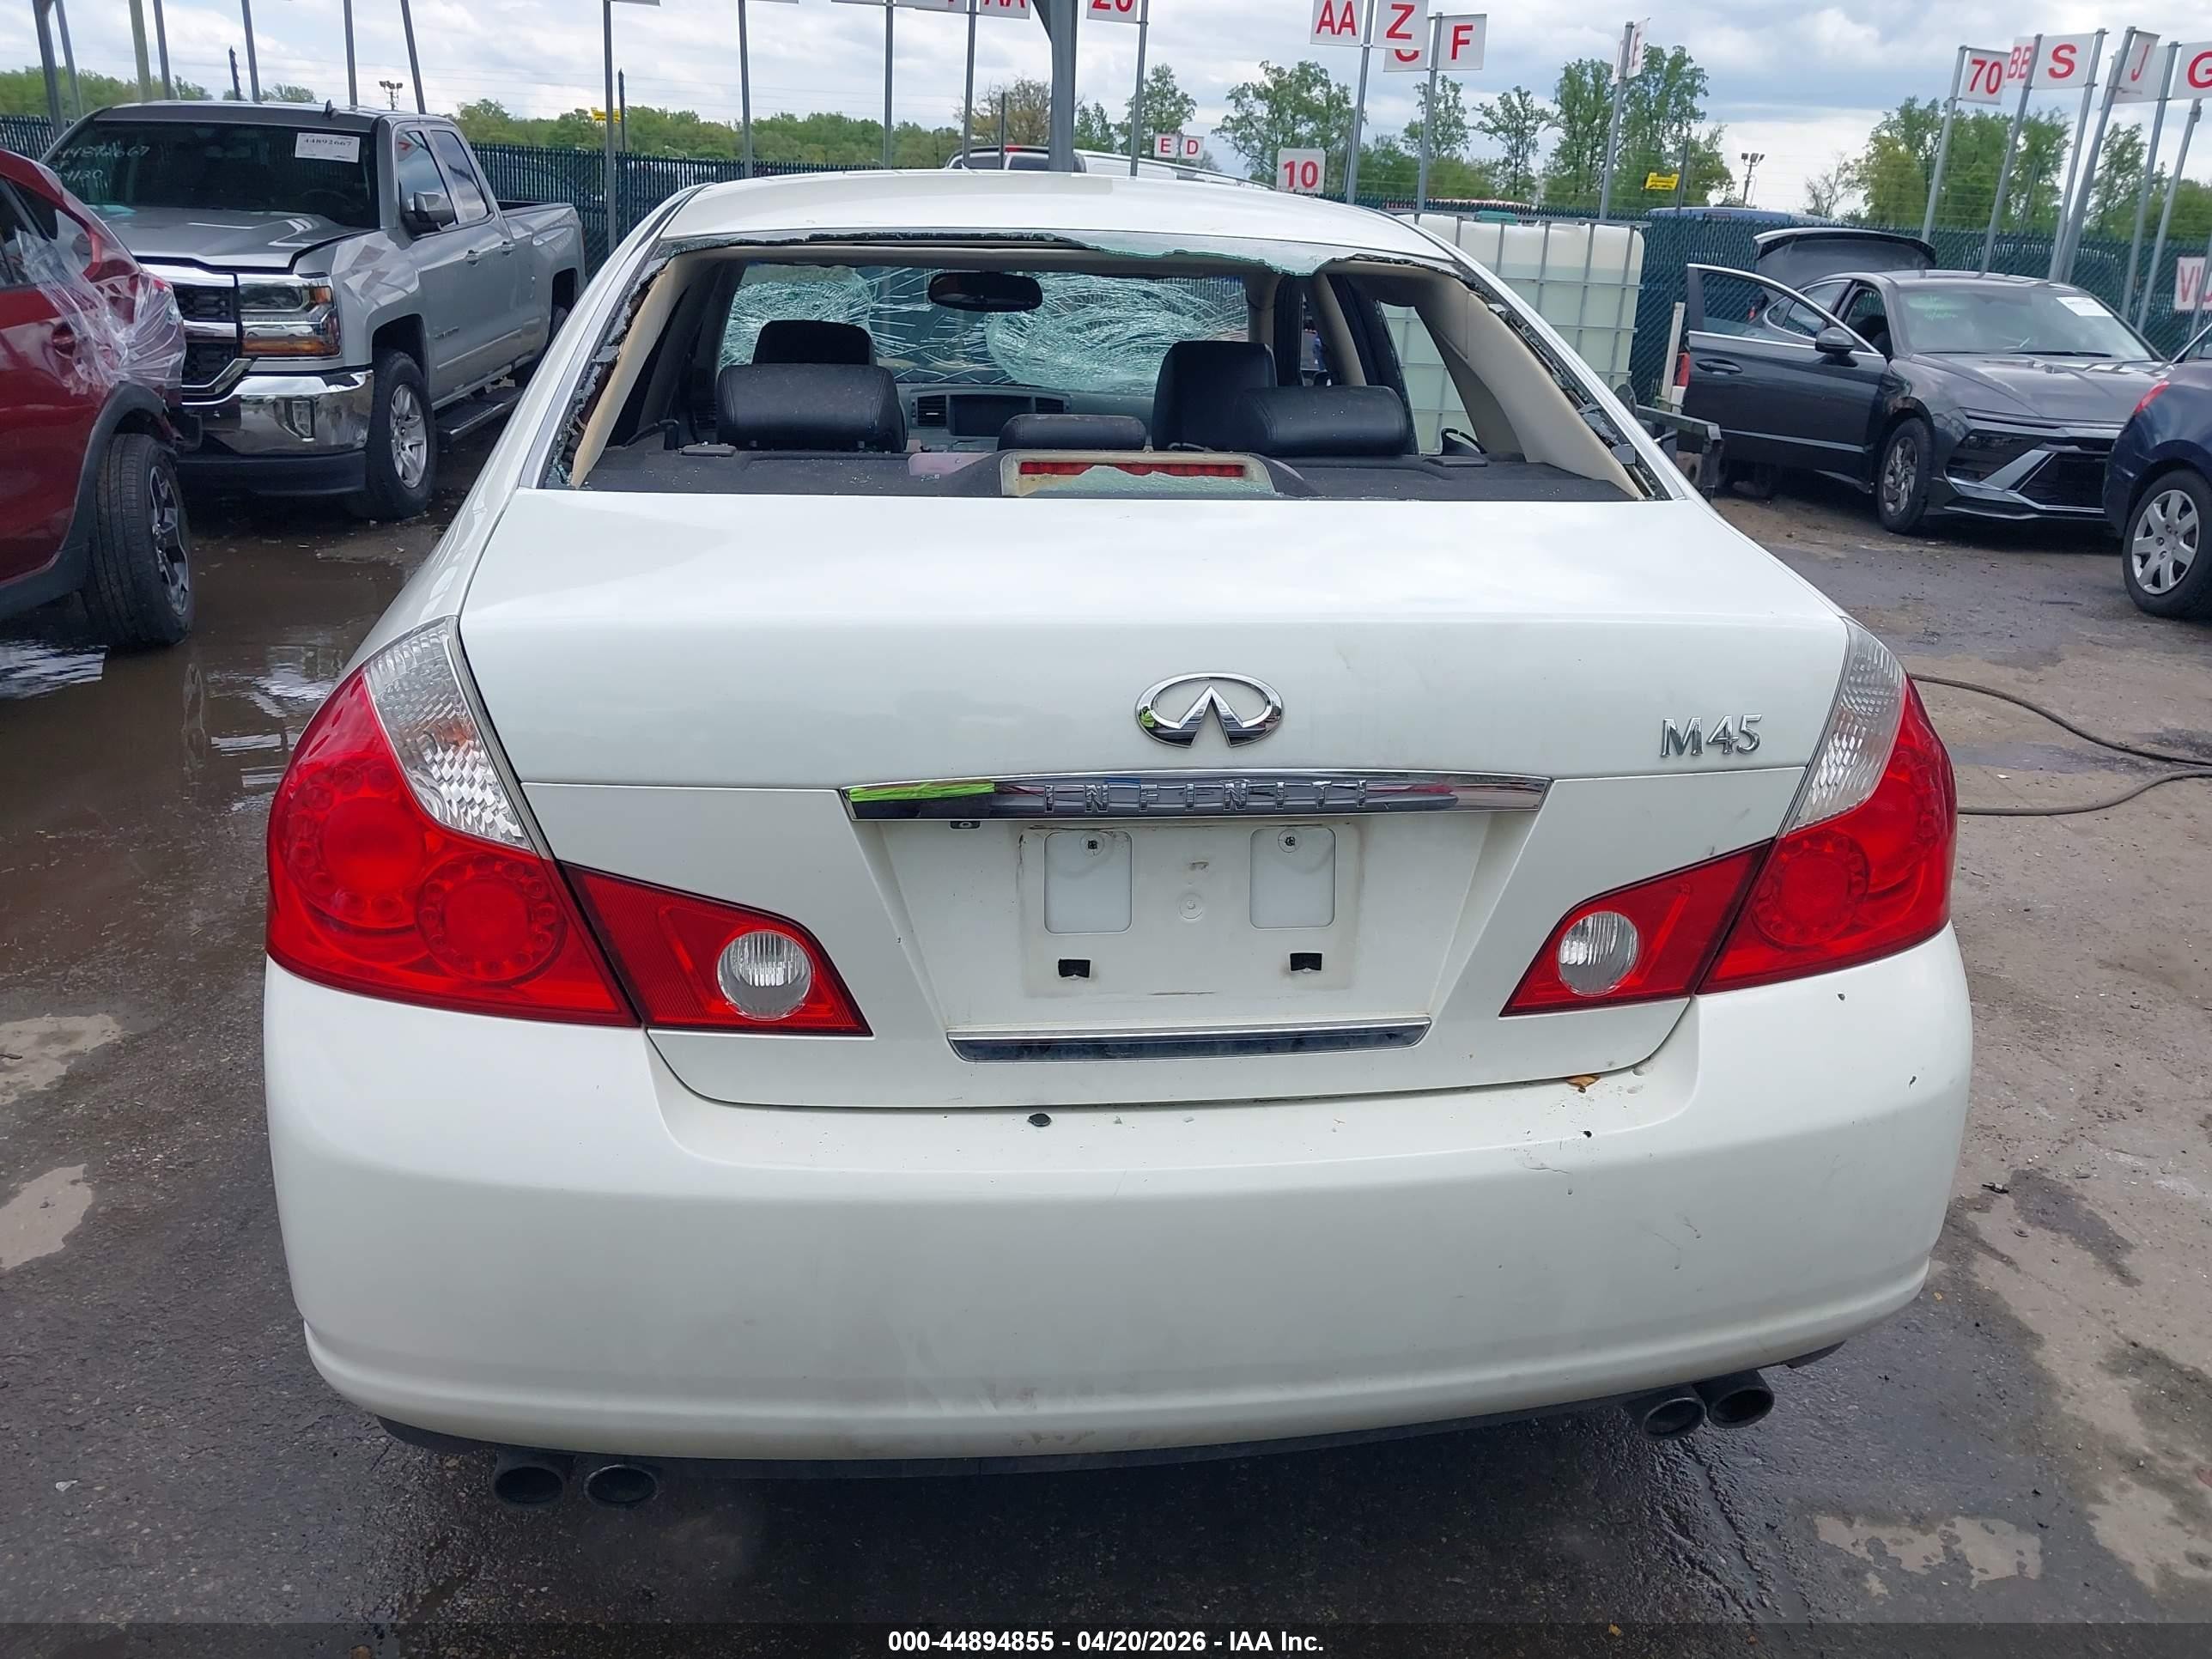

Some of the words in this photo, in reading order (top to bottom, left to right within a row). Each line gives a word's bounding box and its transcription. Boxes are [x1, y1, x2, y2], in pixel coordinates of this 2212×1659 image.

[1316, 0, 1357, 36] AA
[1386, 3, 1415, 40] Z
[1451, 25, 1474, 60] F
[1969, 58, 2003, 94] 70
[2048, 44, 2077, 79] S
[2130, 44, 2149, 82] J
[1160, 137, 1170, 153] E
[1186, 140, 1199, 155] D
[1284, 161, 1319, 188] 10
[1661, 714, 1762, 757] M45
[1045, 780, 1367, 812] INFINITI
